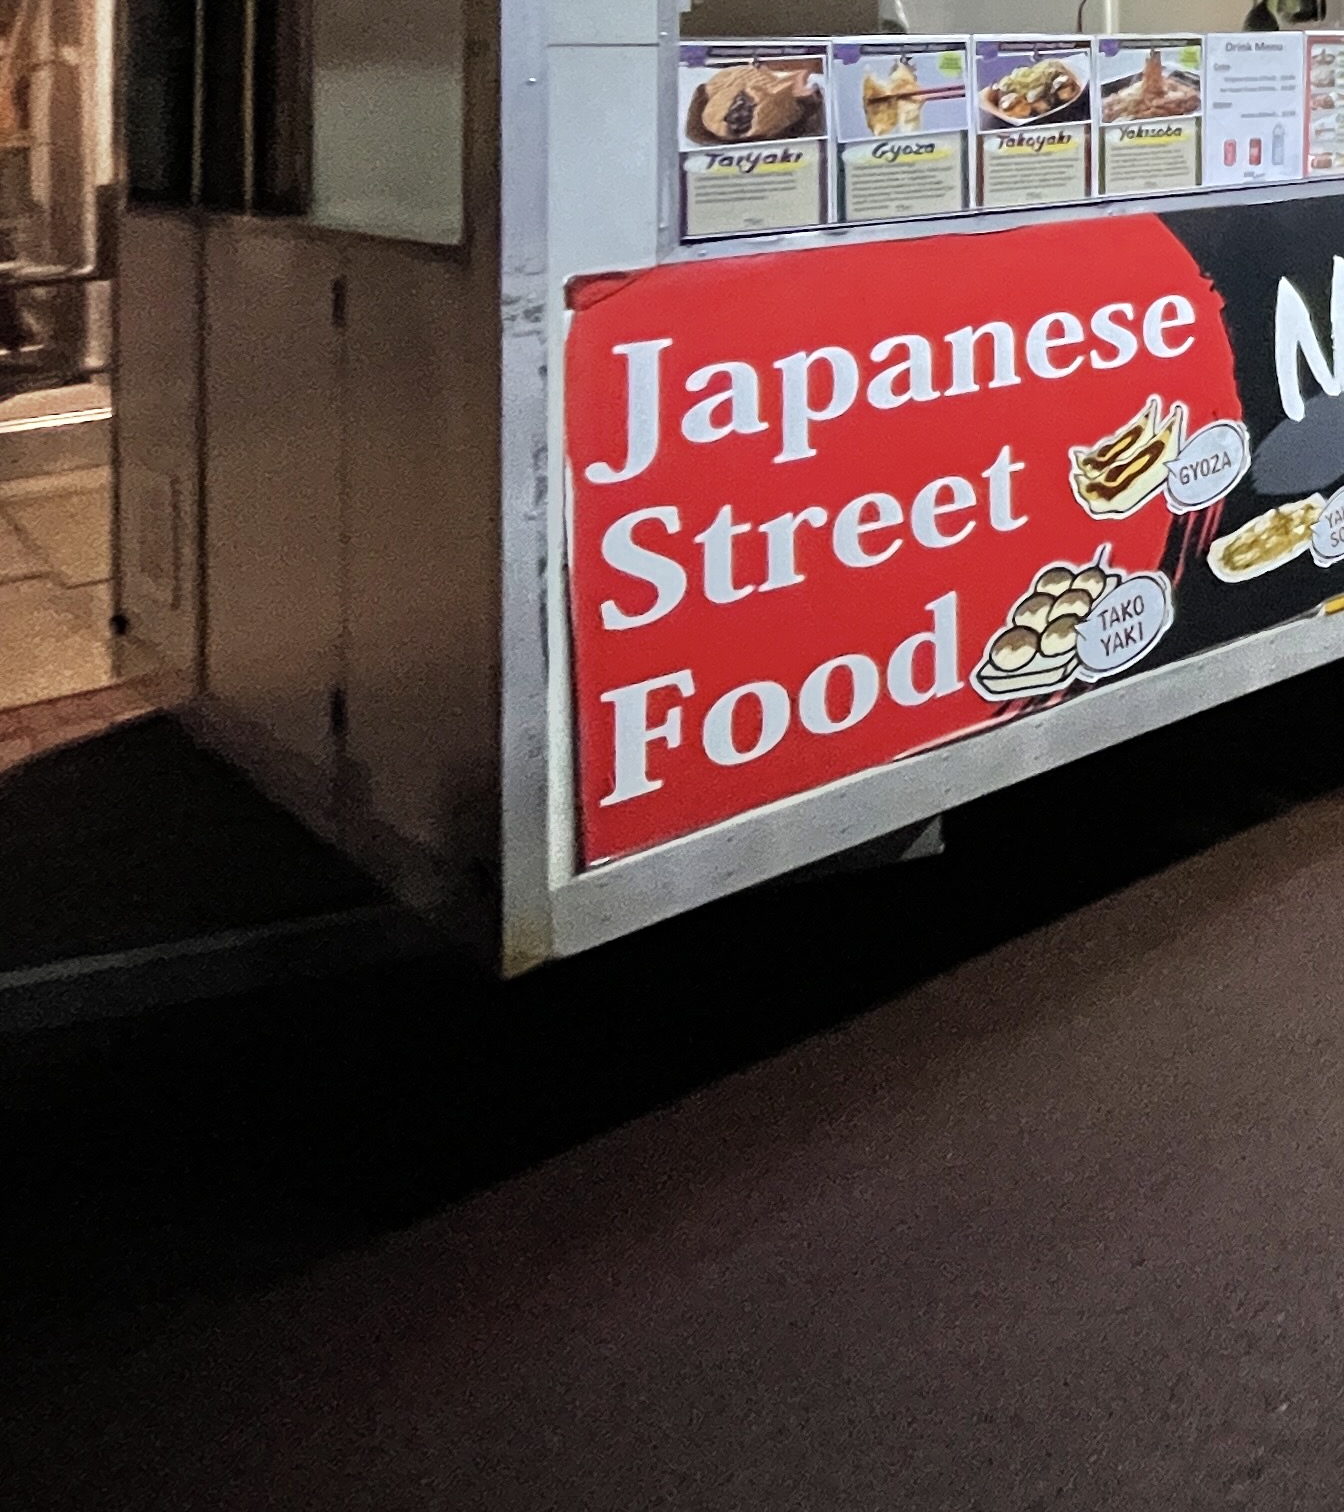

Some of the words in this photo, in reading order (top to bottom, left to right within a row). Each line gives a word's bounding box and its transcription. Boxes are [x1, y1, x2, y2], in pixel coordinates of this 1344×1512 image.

[997, 131, 1072, 152] Takoyaki
[1119, 124, 1183, 141] Yakisoba
[872, 142, 936, 163] Gyoza
[585, 293, 1196, 485] Japanese
[1178, 454, 1233, 486] GYOZA
[599, 445, 1028, 631] Street
[1098, 595, 1145, 625] TAKO
[1100, 622, 1145, 657] YAKI
[598, 591, 965, 808] Food
